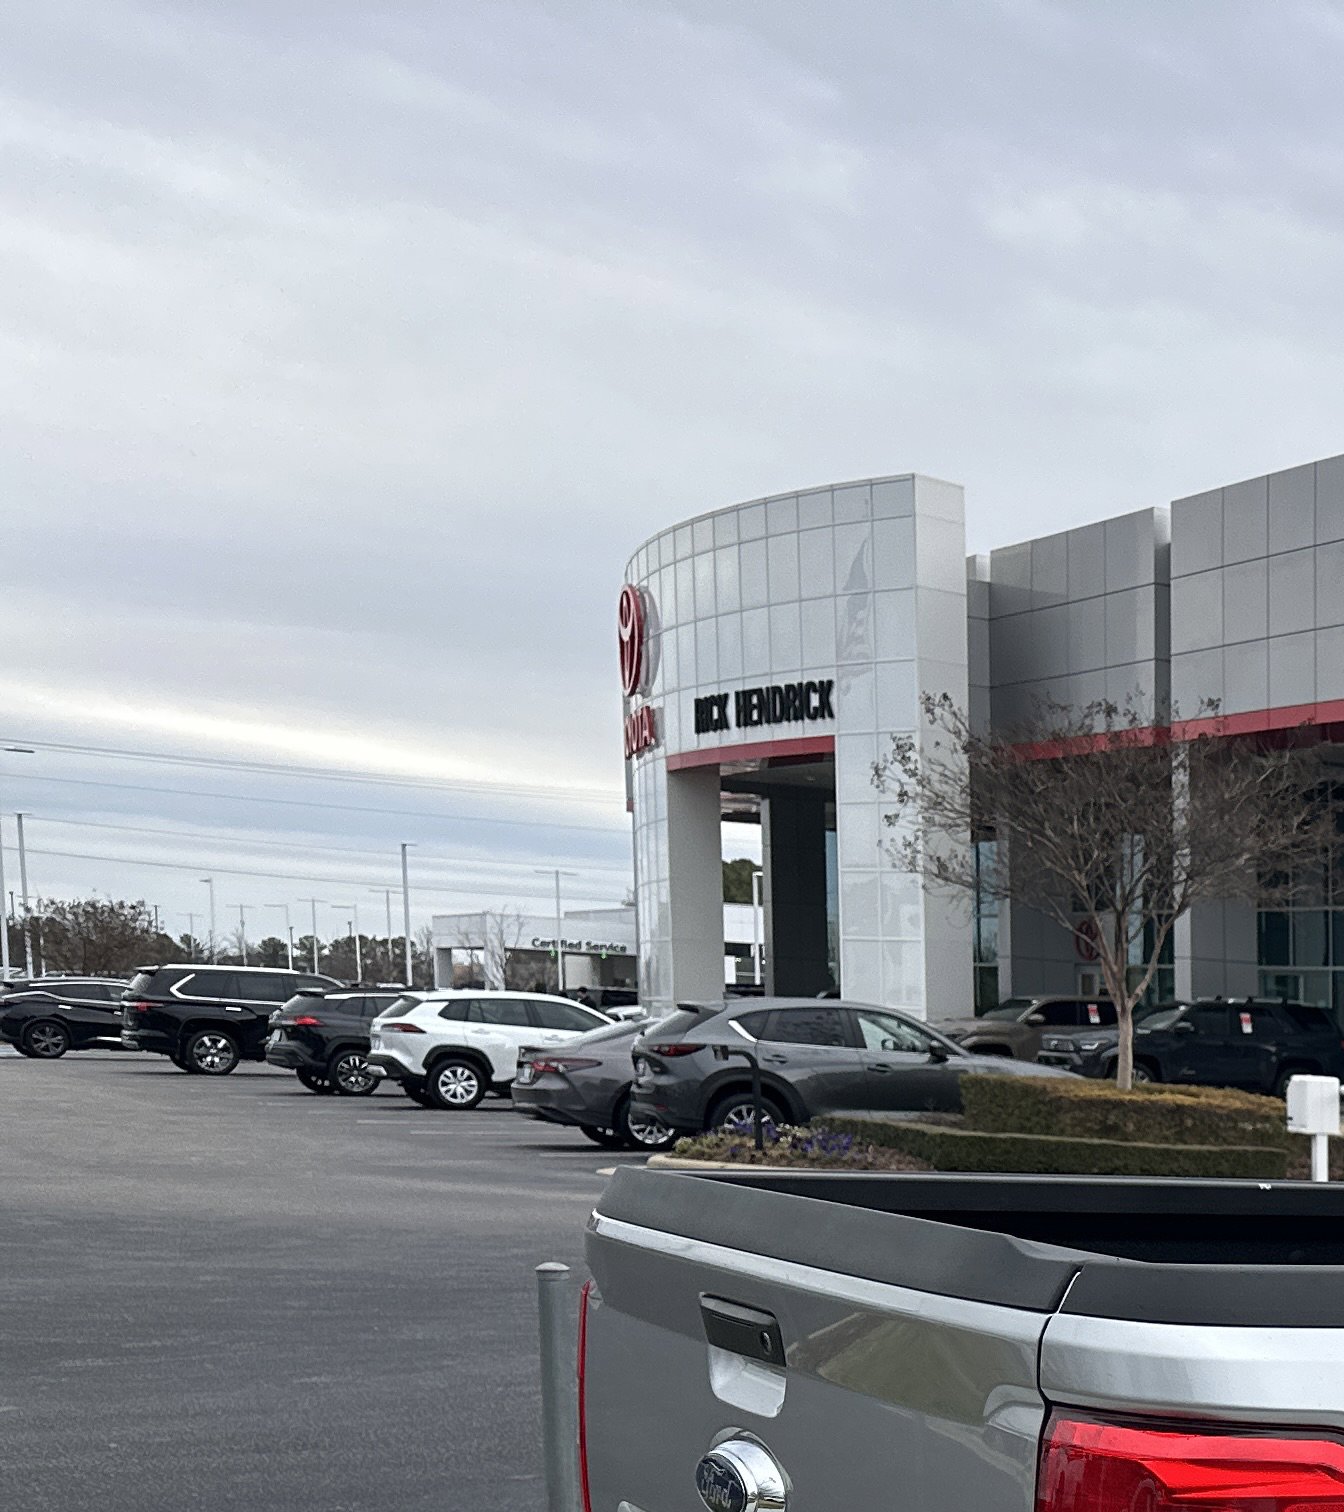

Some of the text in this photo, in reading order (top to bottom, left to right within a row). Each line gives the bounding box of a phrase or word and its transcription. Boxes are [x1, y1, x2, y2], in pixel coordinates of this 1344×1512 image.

[694, 679, 835, 734] RICK HENDRICK
[532, 938, 627, 953] Certified Service
[701, 1462, 740, 1509] Ford
